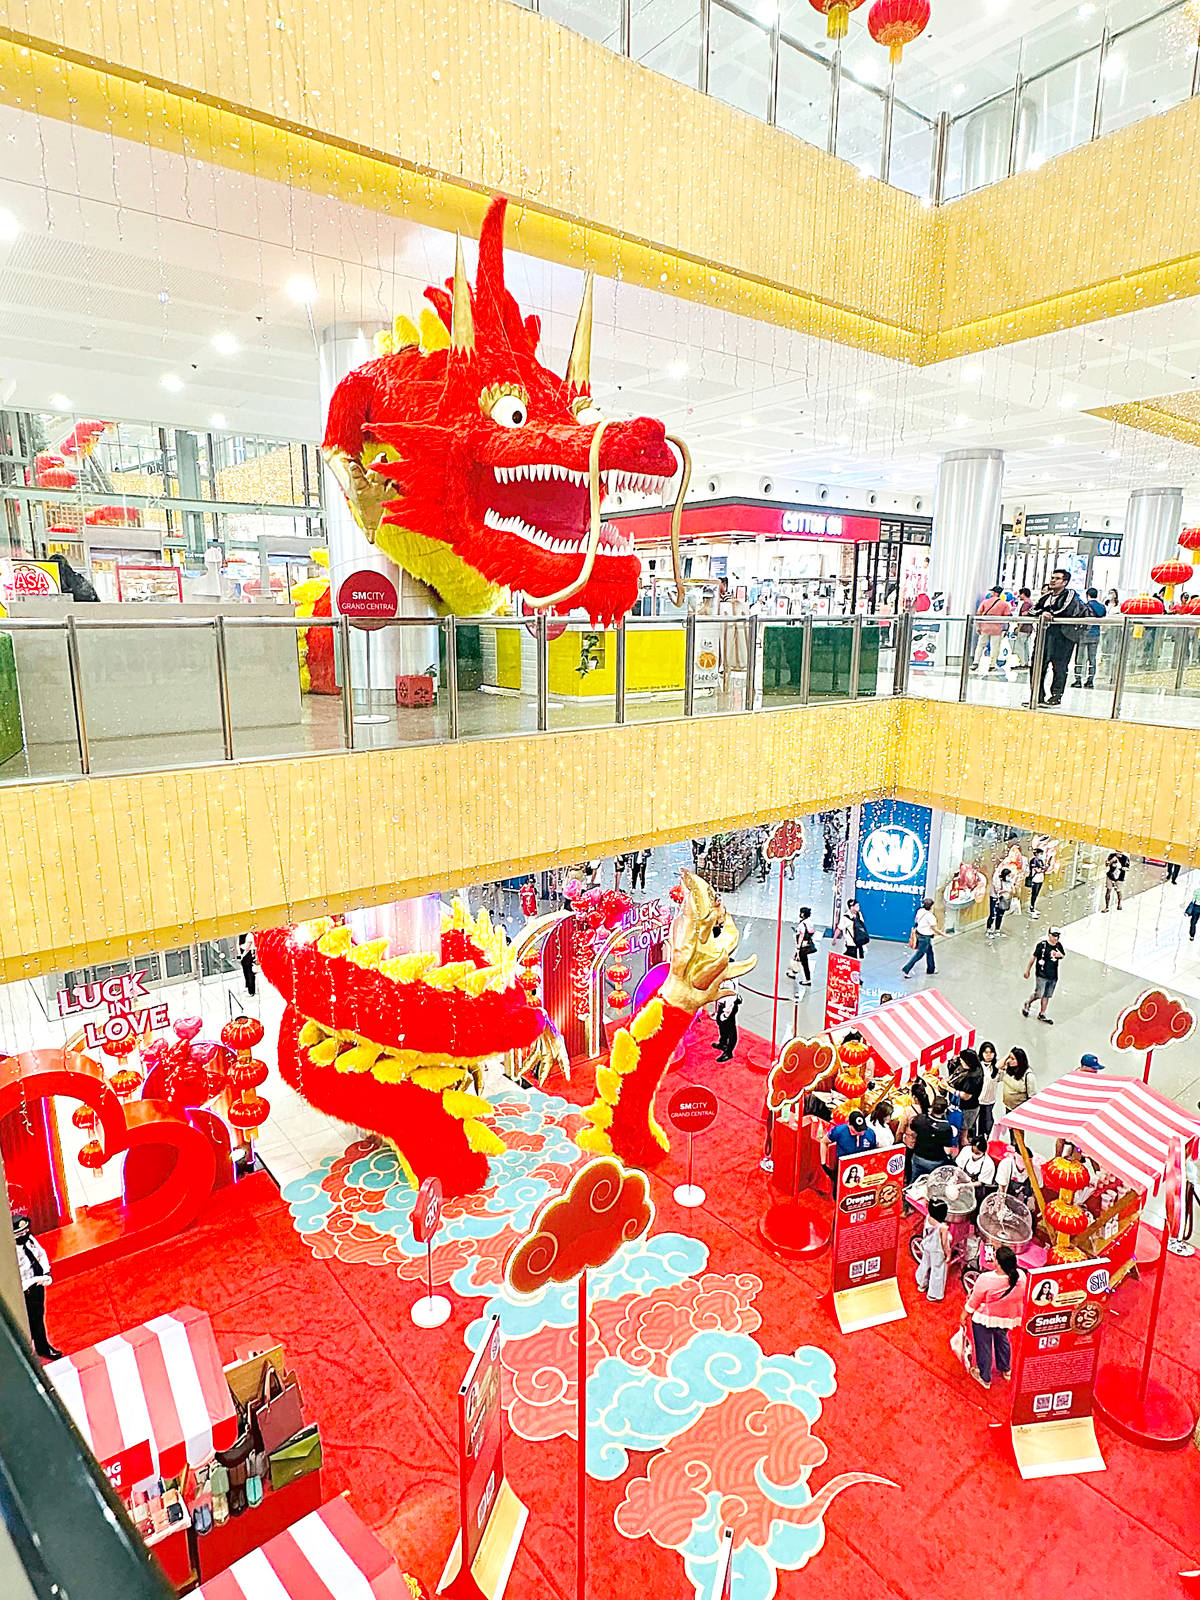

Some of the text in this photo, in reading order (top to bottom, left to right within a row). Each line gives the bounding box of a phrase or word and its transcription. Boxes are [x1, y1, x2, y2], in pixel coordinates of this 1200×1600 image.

[342, 602, 395, 611] GRAND CENTRAL
[855, 880, 925, 896] SUPERMARKET
[621, 899, 660, 930] LUCK
[630, 925, 670, 953] LOVE
[57, 970, 149, 1016] LUCK
[108, 999, 131, 1016] IN
[84, 1003, 170, 1049] LOVE
[846, 1194, 874, 1206] Dragon
[1036, 1314, 1068, 1327] Snake
